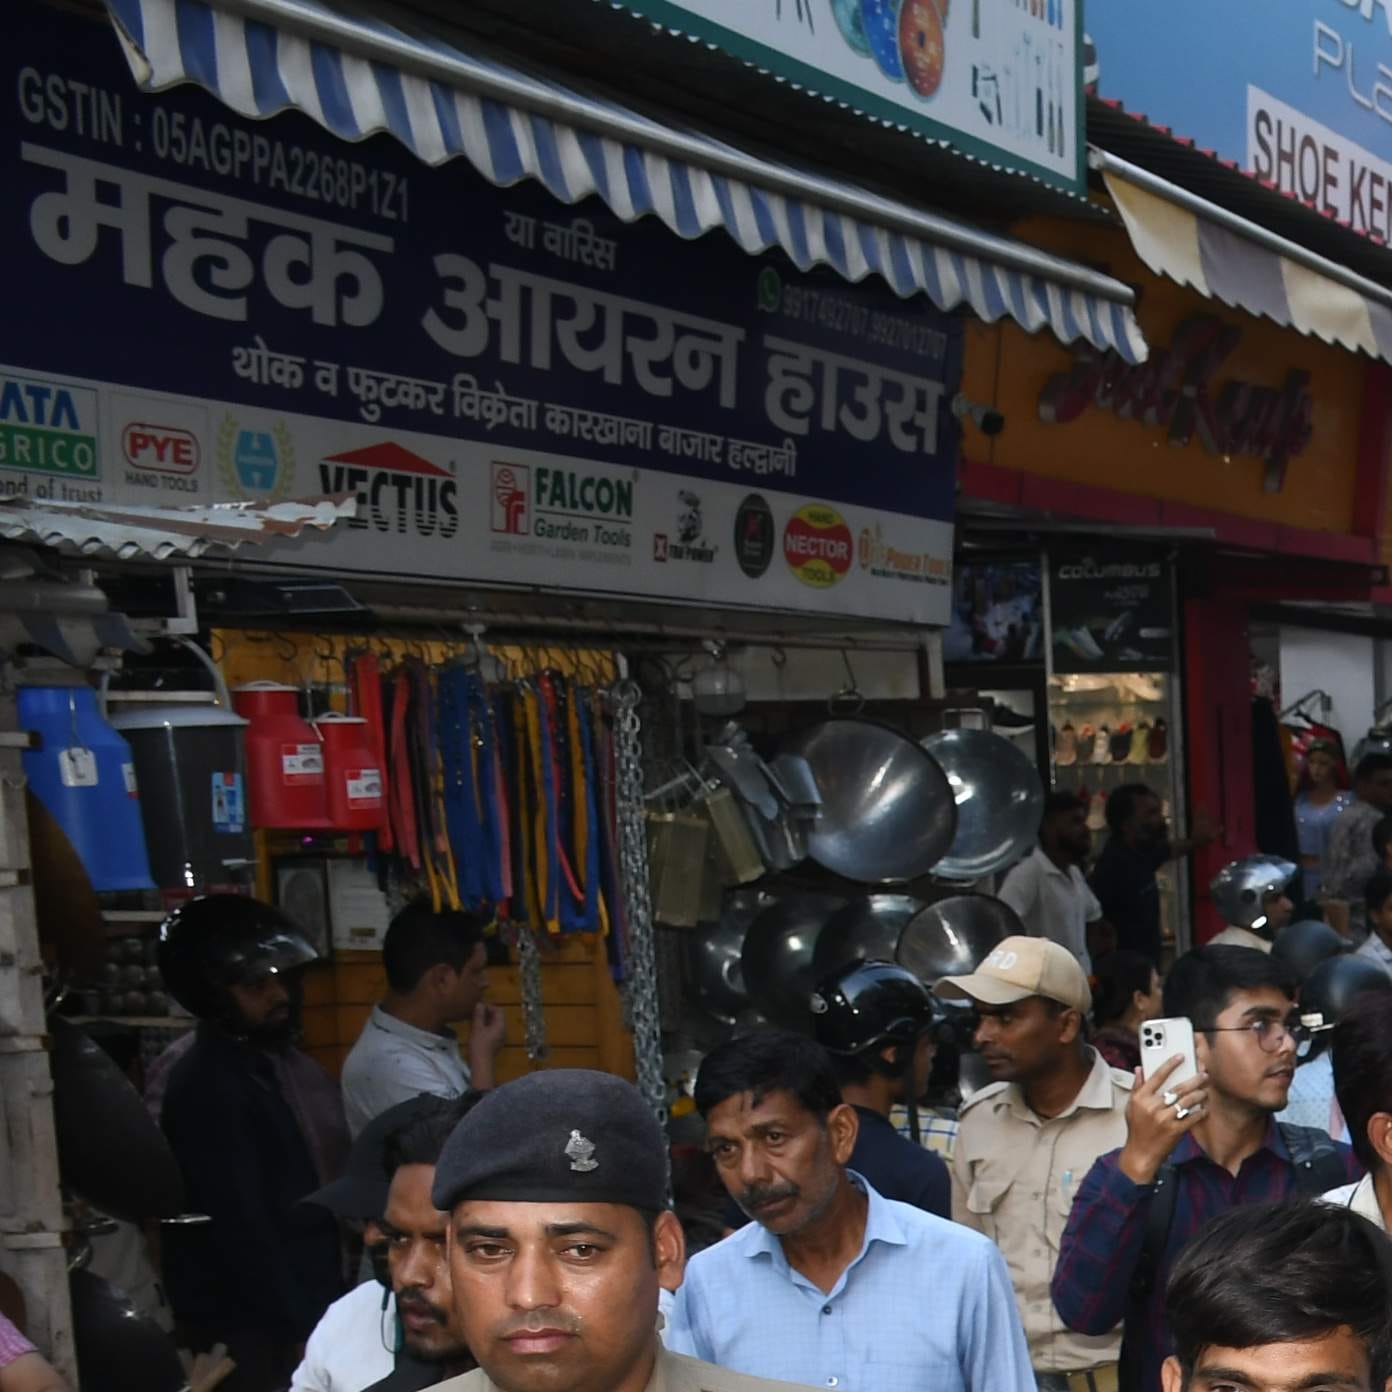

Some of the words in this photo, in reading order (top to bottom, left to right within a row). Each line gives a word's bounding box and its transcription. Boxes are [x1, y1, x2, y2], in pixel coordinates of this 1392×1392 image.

[19, 67, 122, 146] GSTIN
[1254, 109, 1340, 218] SHOE
[21, 141, 395, 328] महक
[422, 254, 746, 407] आयरन
[762, 334, 944, 455] हाउस
[231, 335, 305, 385] थोक
[313, 358, 338, 396] व
[348, 363, 446, 422] फुटकर
[452, 372, 539, 430] विक्रेता
[544, 402, 652, 450] कारखाना
[656, 430, 726, 464] बाजार
[727, 437, 797, 477] हल्द्वानी
[129, 431, 193, 466] PYE
[36, 478, 55, 500] of
[124, 470, 159, 488] HAND
[161, 475, 199, 494] TOOLS
[535, 466, 634, 518] FALCON
[534, 518, 589, 543] Garden
[593, 524, 632, 548] Tools
[785, 533, 849, 561] NECTOR
